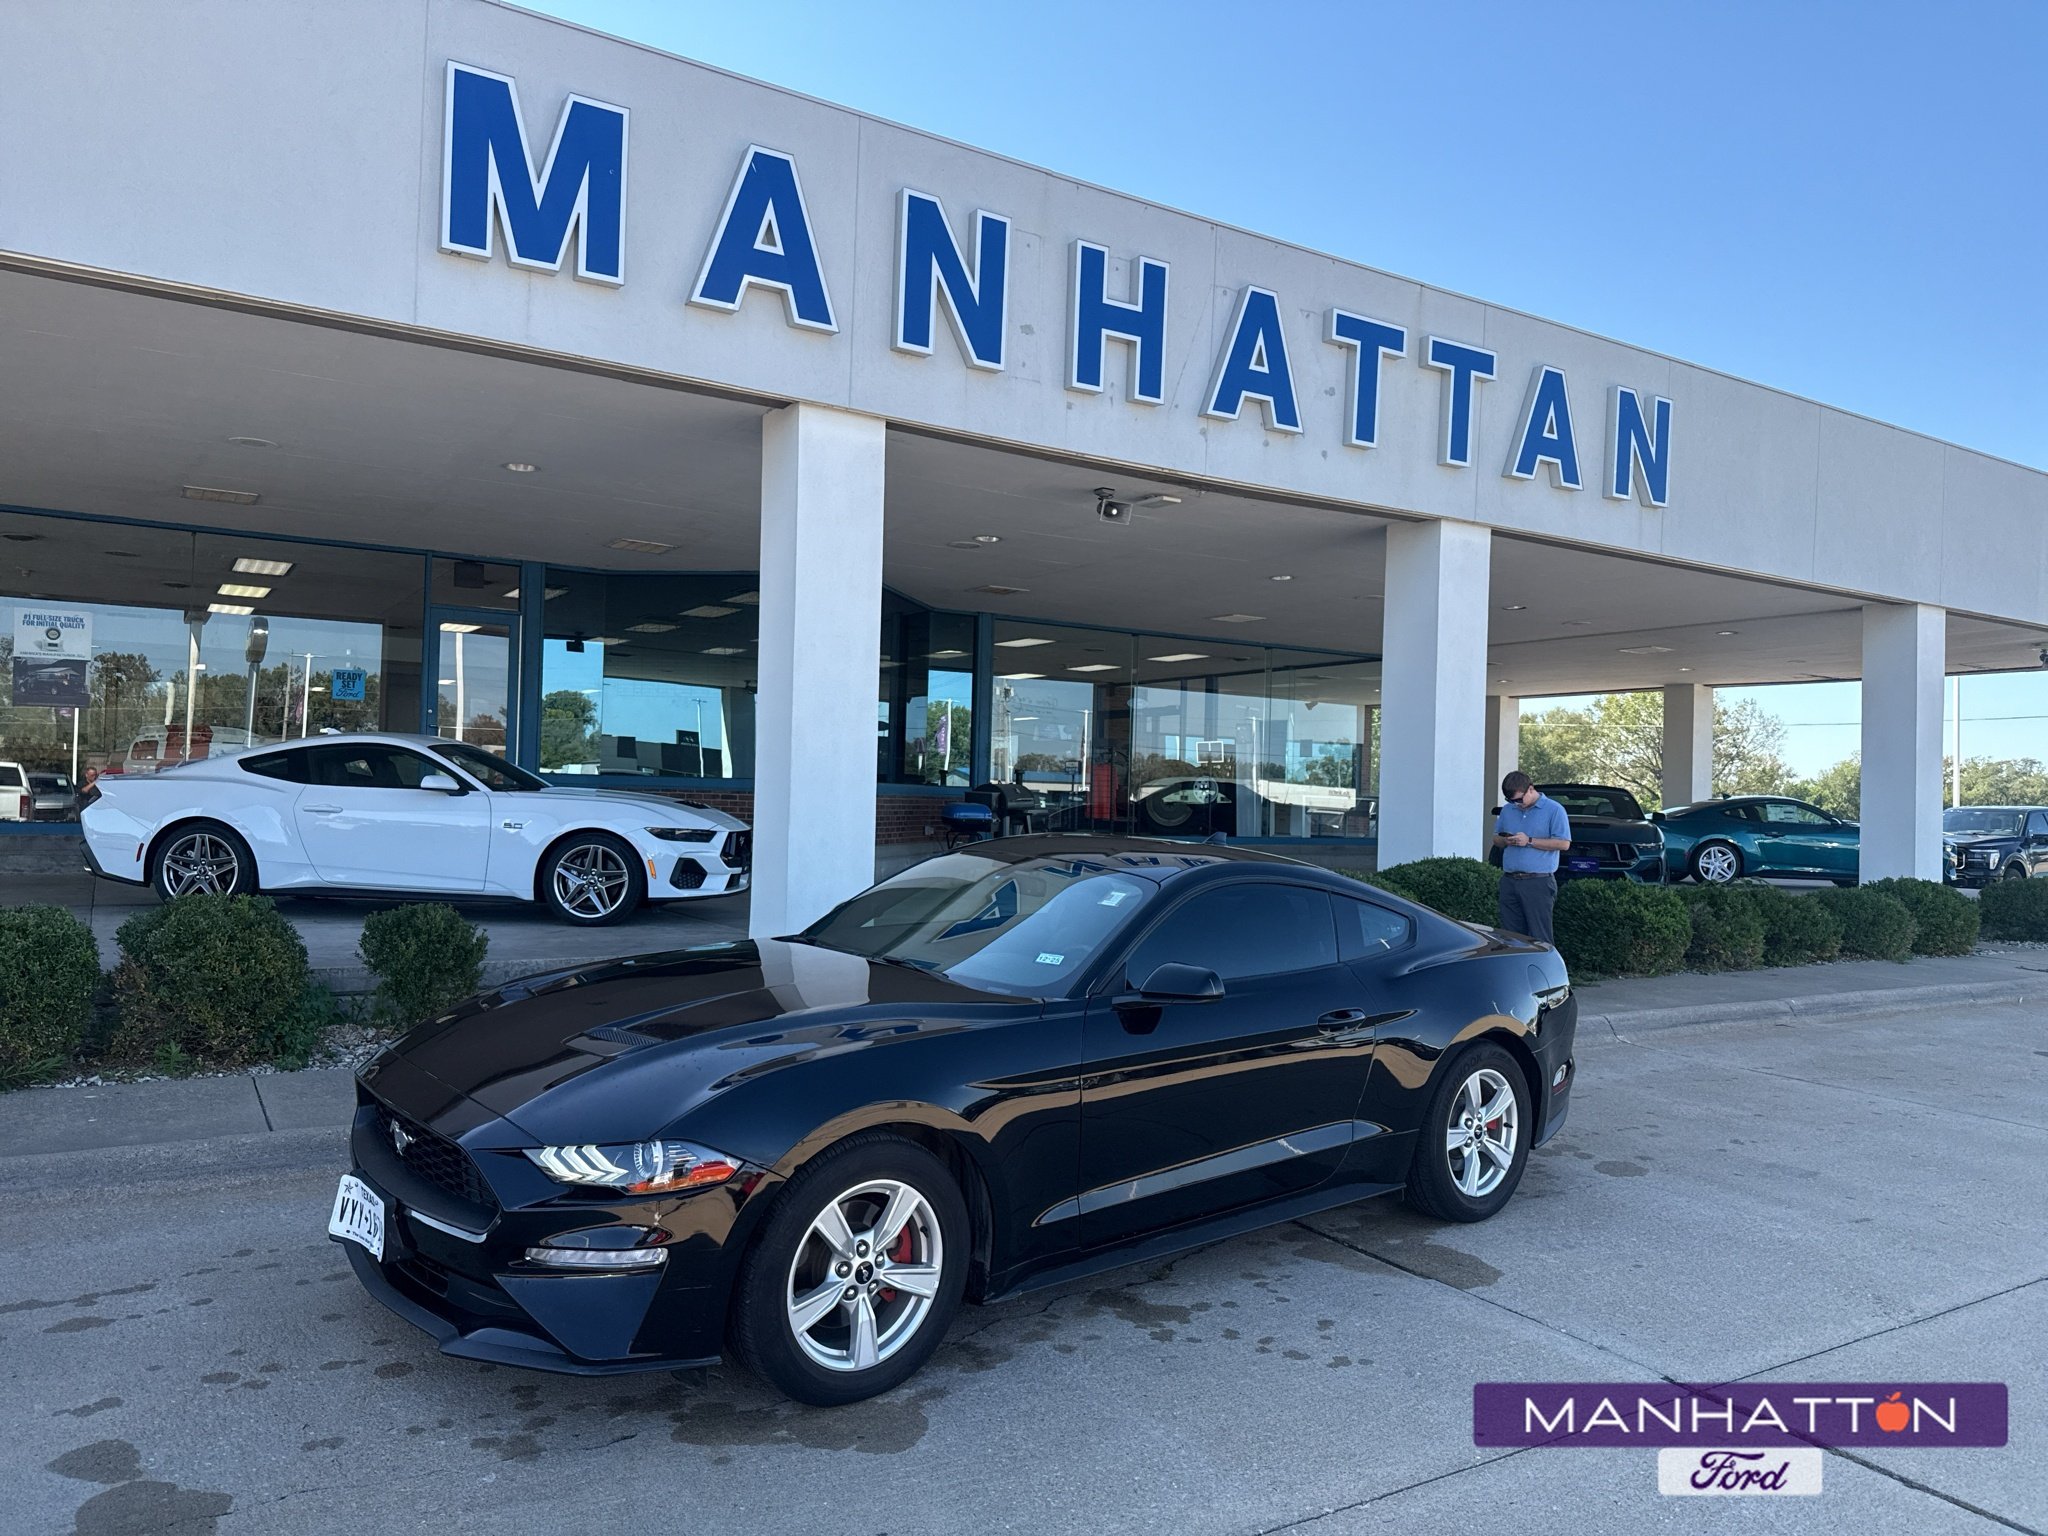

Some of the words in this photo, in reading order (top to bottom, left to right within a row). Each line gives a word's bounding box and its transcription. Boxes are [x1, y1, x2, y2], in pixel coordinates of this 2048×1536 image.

[439, 60, 1671, 509] MANHATTAN
[32, 614, 62, 622] FULL-SIZE
[60, 621, 85, 629] QUALITY
[336, 671, 362, 681] READY
[341, 680, 356, 689] SET
[336, 688, 360, 698] Ford
[360, 1186, 375, 1207] TEXAS
